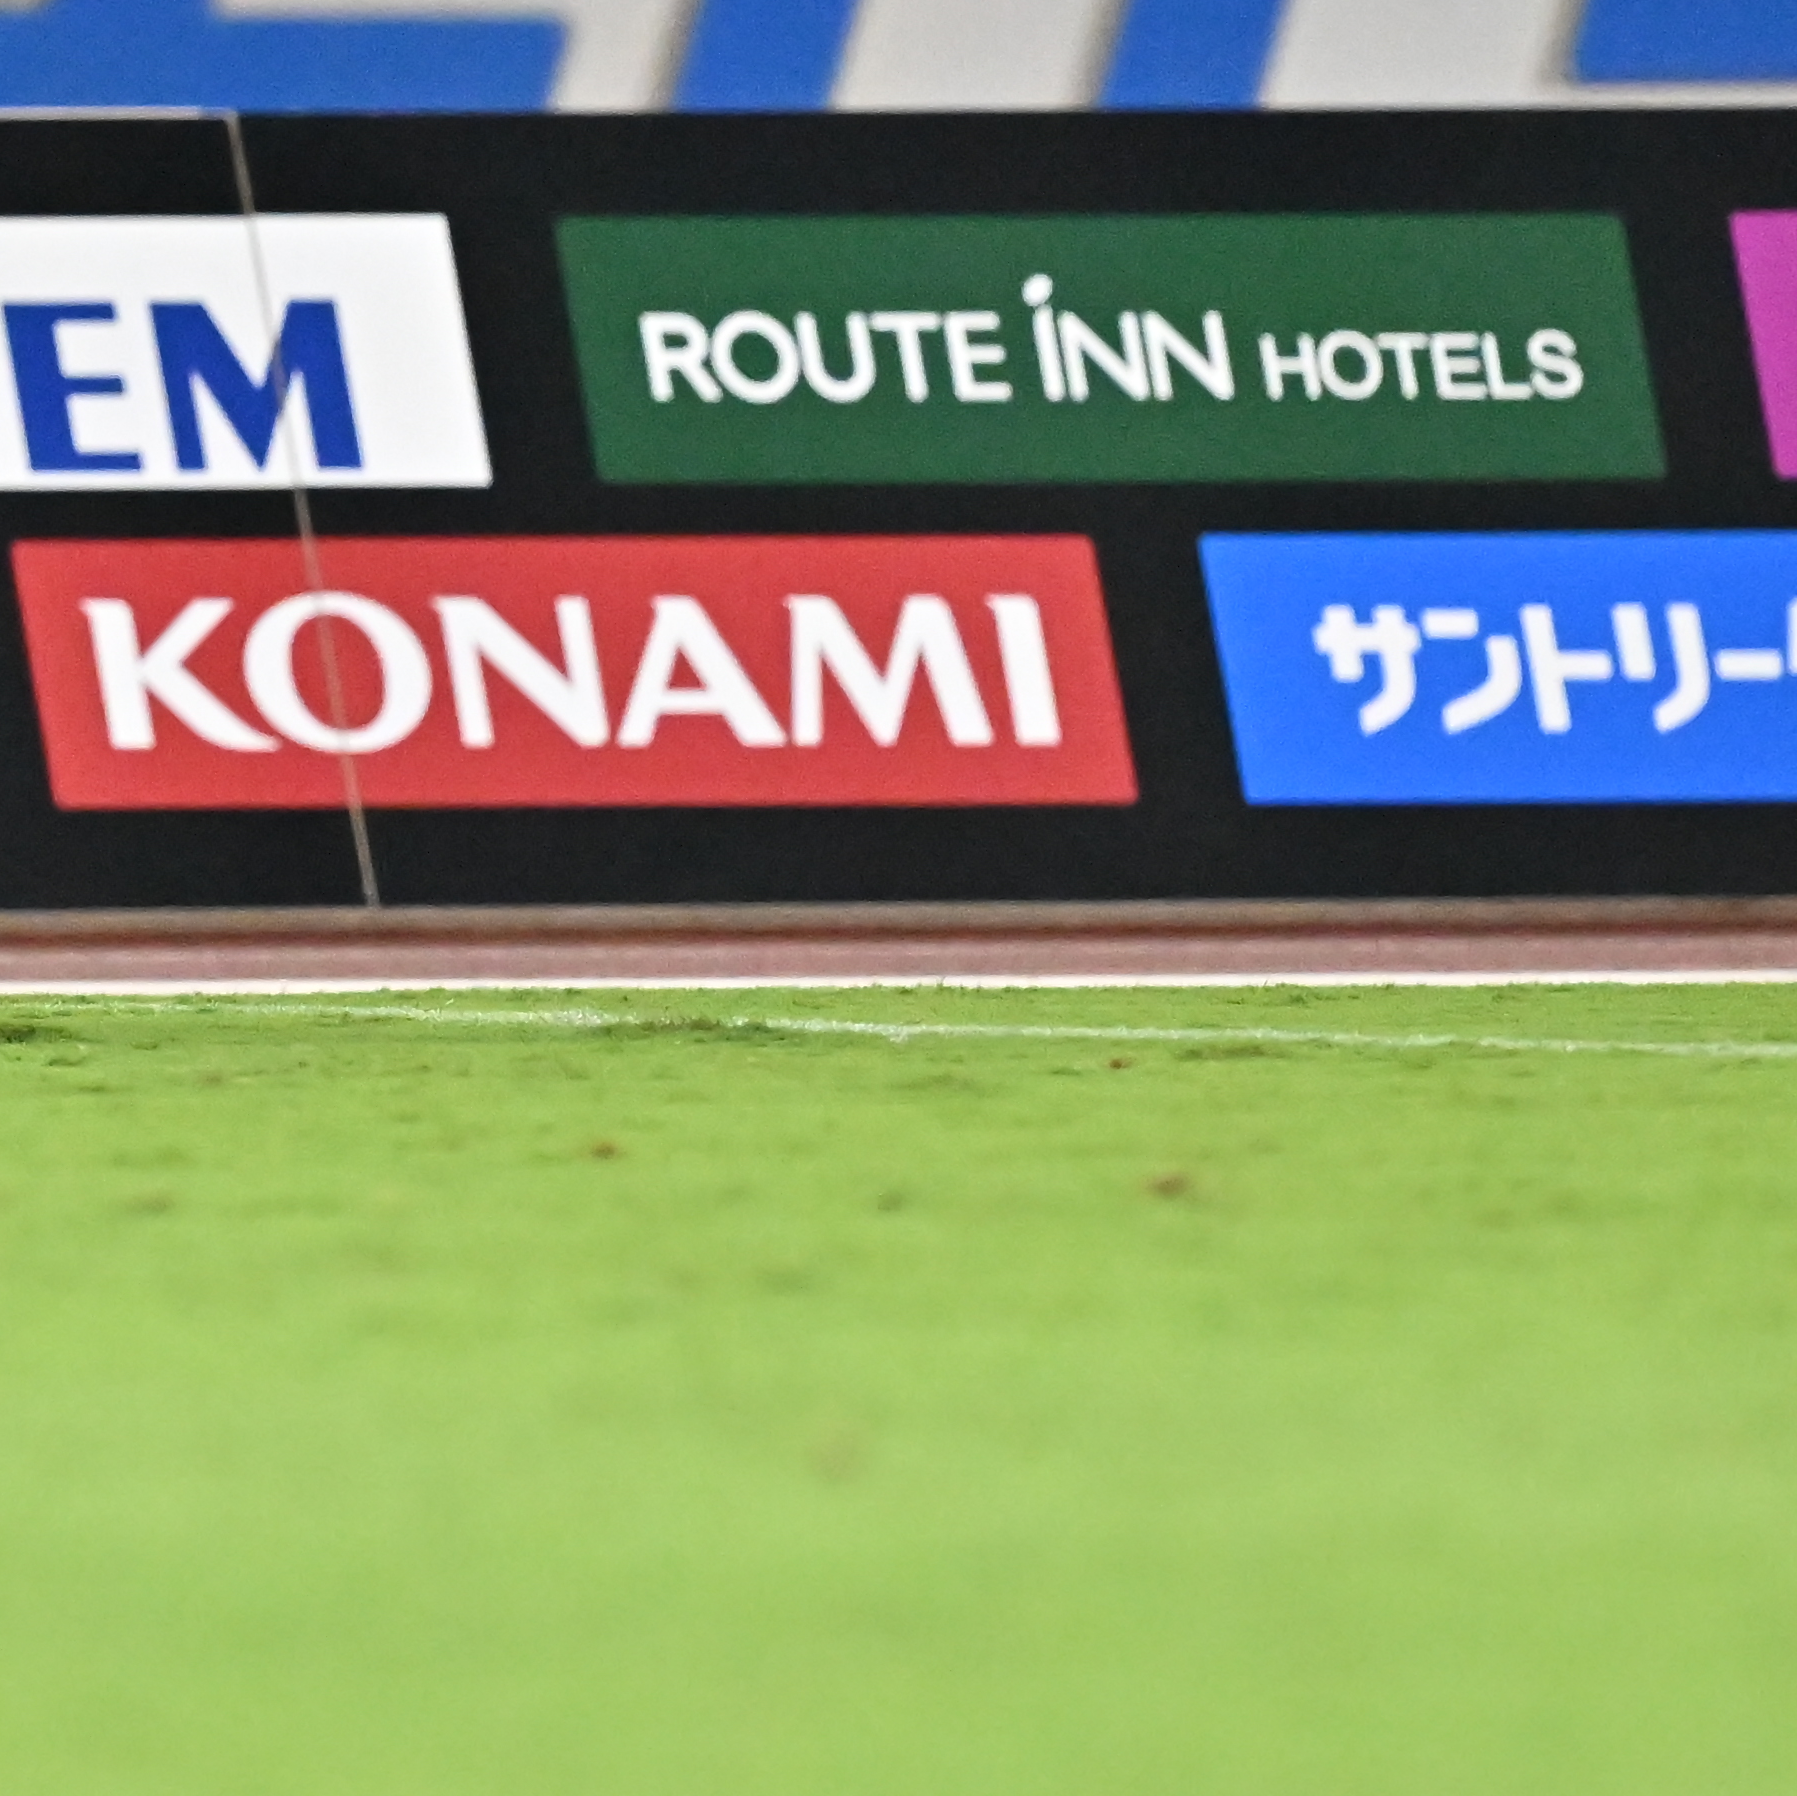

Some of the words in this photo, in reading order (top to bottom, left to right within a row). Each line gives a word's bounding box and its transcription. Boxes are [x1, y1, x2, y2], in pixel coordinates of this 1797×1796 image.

[638, 308, 1012, 404] ROUTE
[1257, 328, 1585, 402] HOTELS
[79, 590, 1063, 755] KONAMI
[1313, 599, 1797, 735] サントリー
